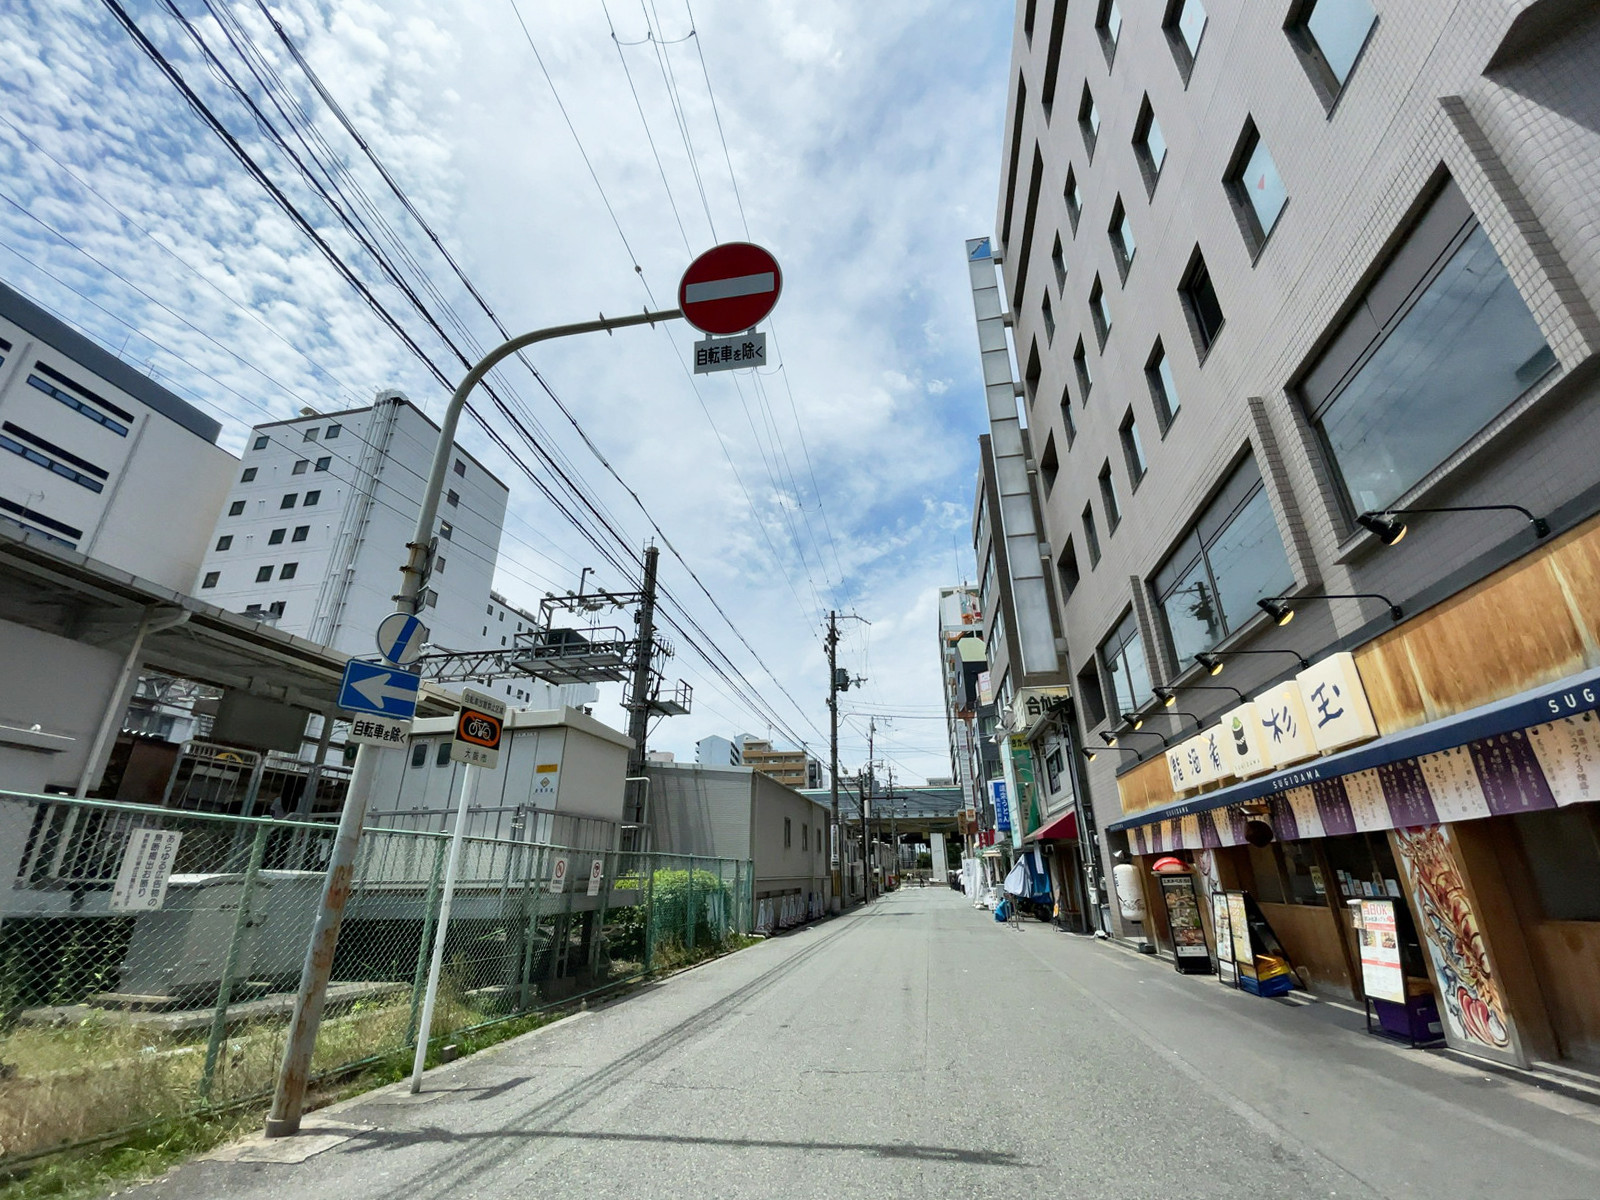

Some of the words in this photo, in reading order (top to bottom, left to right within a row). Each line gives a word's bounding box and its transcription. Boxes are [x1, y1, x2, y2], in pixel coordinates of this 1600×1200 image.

[697, 341, 763, 366] 自転車を除く
[1261, 682, 1344, 744] 杉玉
[353, 719, 407, 744] 自転車を除く
[1272, 768, 1320, 789] SUGIDAMA
